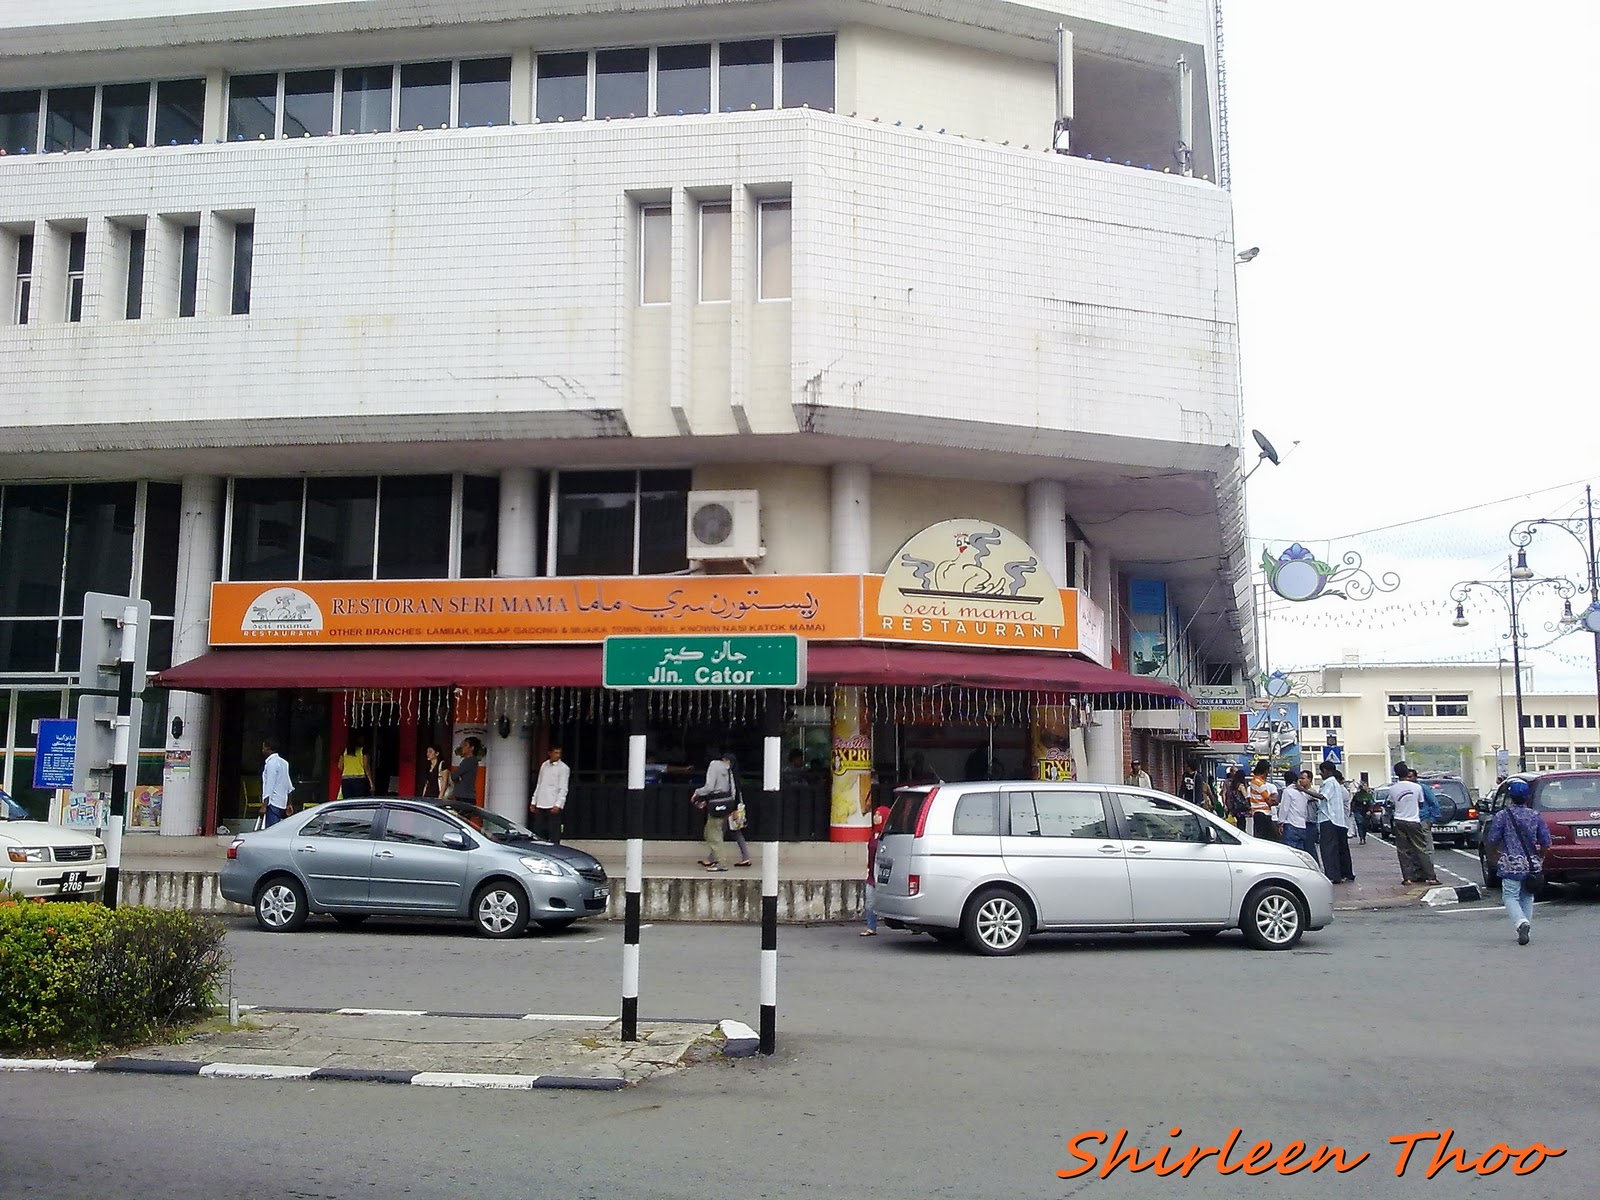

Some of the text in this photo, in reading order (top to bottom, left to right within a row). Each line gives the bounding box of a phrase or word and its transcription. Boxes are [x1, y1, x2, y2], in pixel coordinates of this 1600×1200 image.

[331, 595, 568, 615] RESTORAN SERI MAMA
[573, 580, 622, 612] ماما
[623, 588, 705, 619] سري
[902, 601, 1037, 622] seri mama
[329, 628, 362, 636] OTHER
[722, 624, 746, 632] NASI
[749, 623, 786, 632] KATOK
[789, 623, 827, 632] MAMA)
[881, 616, 1062, 639] RESTAURANT
[710, 640, 748, 665] جالن
[647, 666, 755, 684] Jln. Cator
[62, 881, 83, 892] 2706
[69, 872, 80, 881] BT
